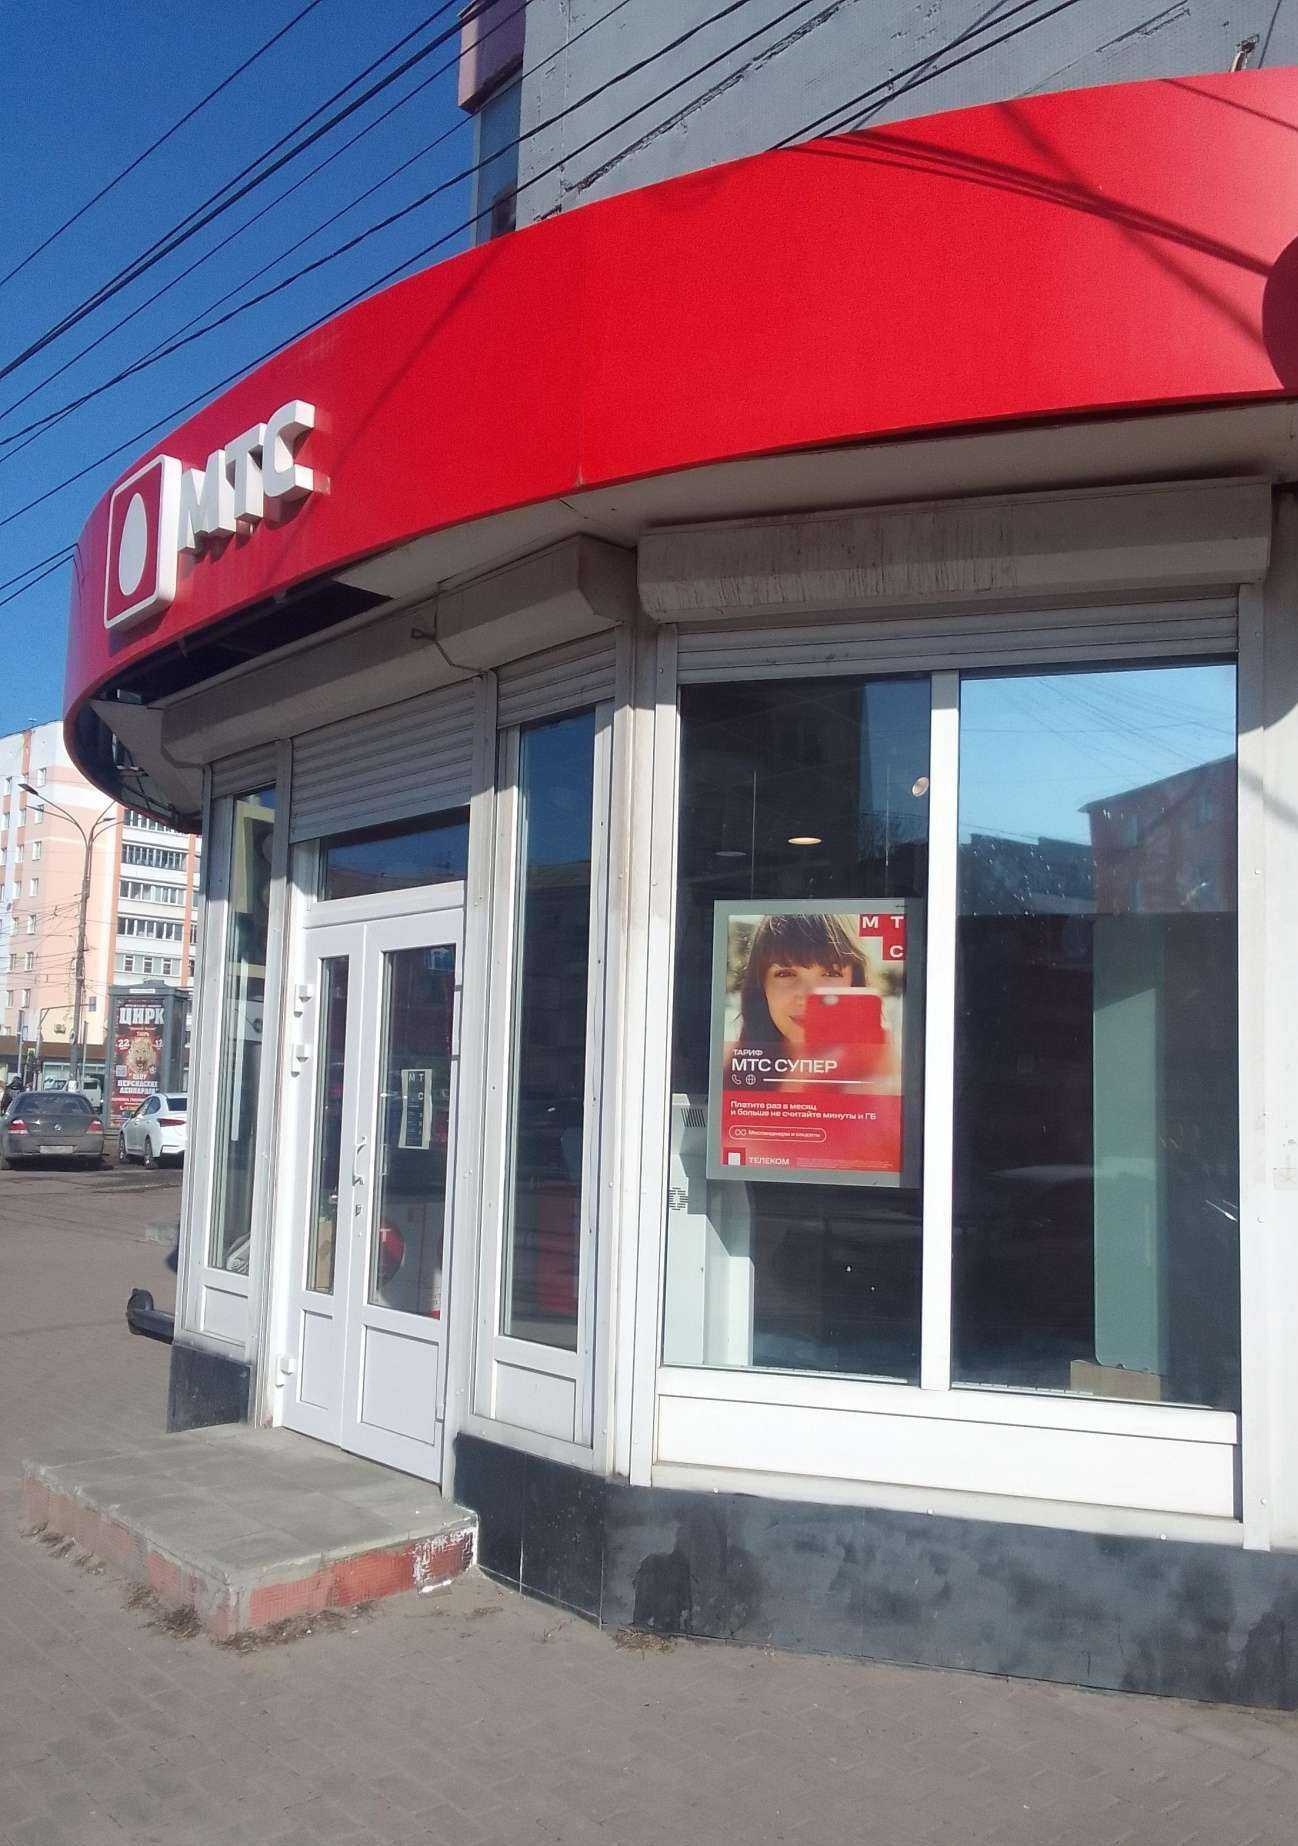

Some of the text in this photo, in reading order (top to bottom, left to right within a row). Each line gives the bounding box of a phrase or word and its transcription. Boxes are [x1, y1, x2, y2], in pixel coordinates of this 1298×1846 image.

[177, 399, 315, 553] МТС
[118, 1007, 165, 1026] ЦИРК
[117, 1038, 130, 1048] 22
[733, 1049, 764, 1057] ТАРИФ
[731, 1058, 838, 1073] МТС СУПЕР
[730, 1101, 765, 1110] Платите
[766, 1103, 782, 1111] раз
[730, 1109, 737, 1117] и
[737, 1108, 770, 1117] больше
[770, 1110, 782, 1118] не
[782, 1111, 822, 1119] считайте
[823, 1112, 857, 1121] минуты
[865, 1112, 877, 1121] ГБ
[748, 1156, 790, 1165] ТЕЛЕКОМ
